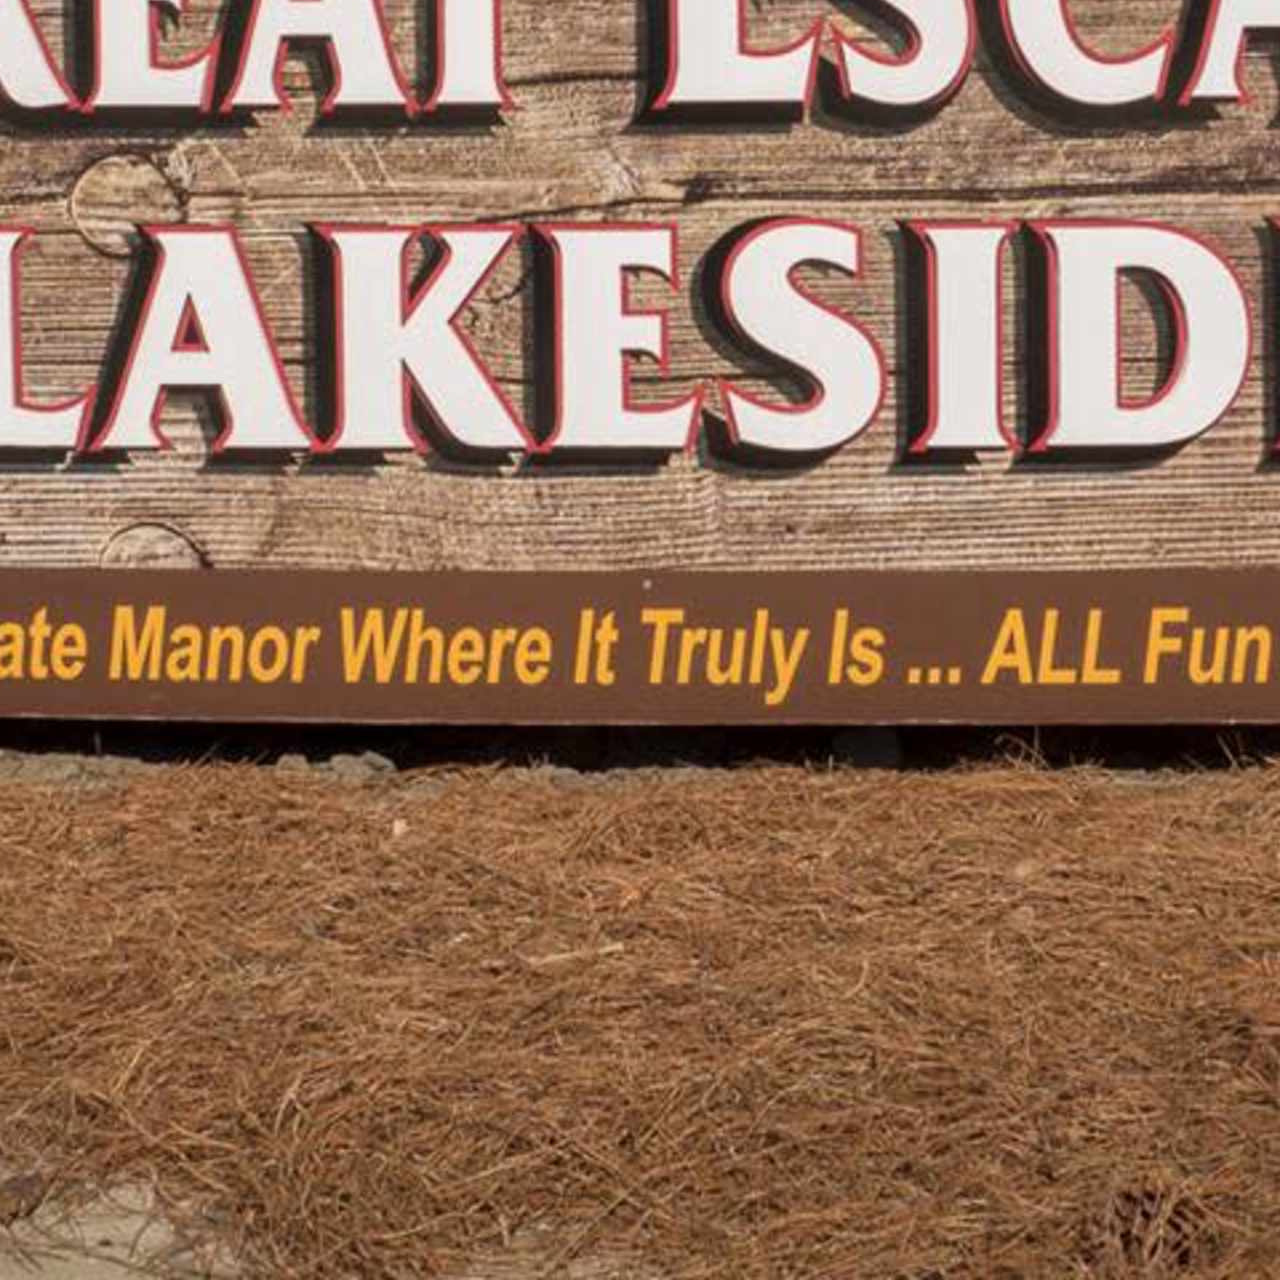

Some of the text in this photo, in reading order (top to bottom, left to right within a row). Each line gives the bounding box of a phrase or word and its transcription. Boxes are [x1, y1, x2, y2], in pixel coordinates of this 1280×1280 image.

[108, 604, 321, 683] Manor
[338, 607, 552, 685] Where
[572, 609, 618, 685] It
[642, 609, 808, 706] Truly
[828, 609, 885, 685] Is
[980, 608, 1121, 685] ALL
[1142, 607, 1271, 685] Fun
